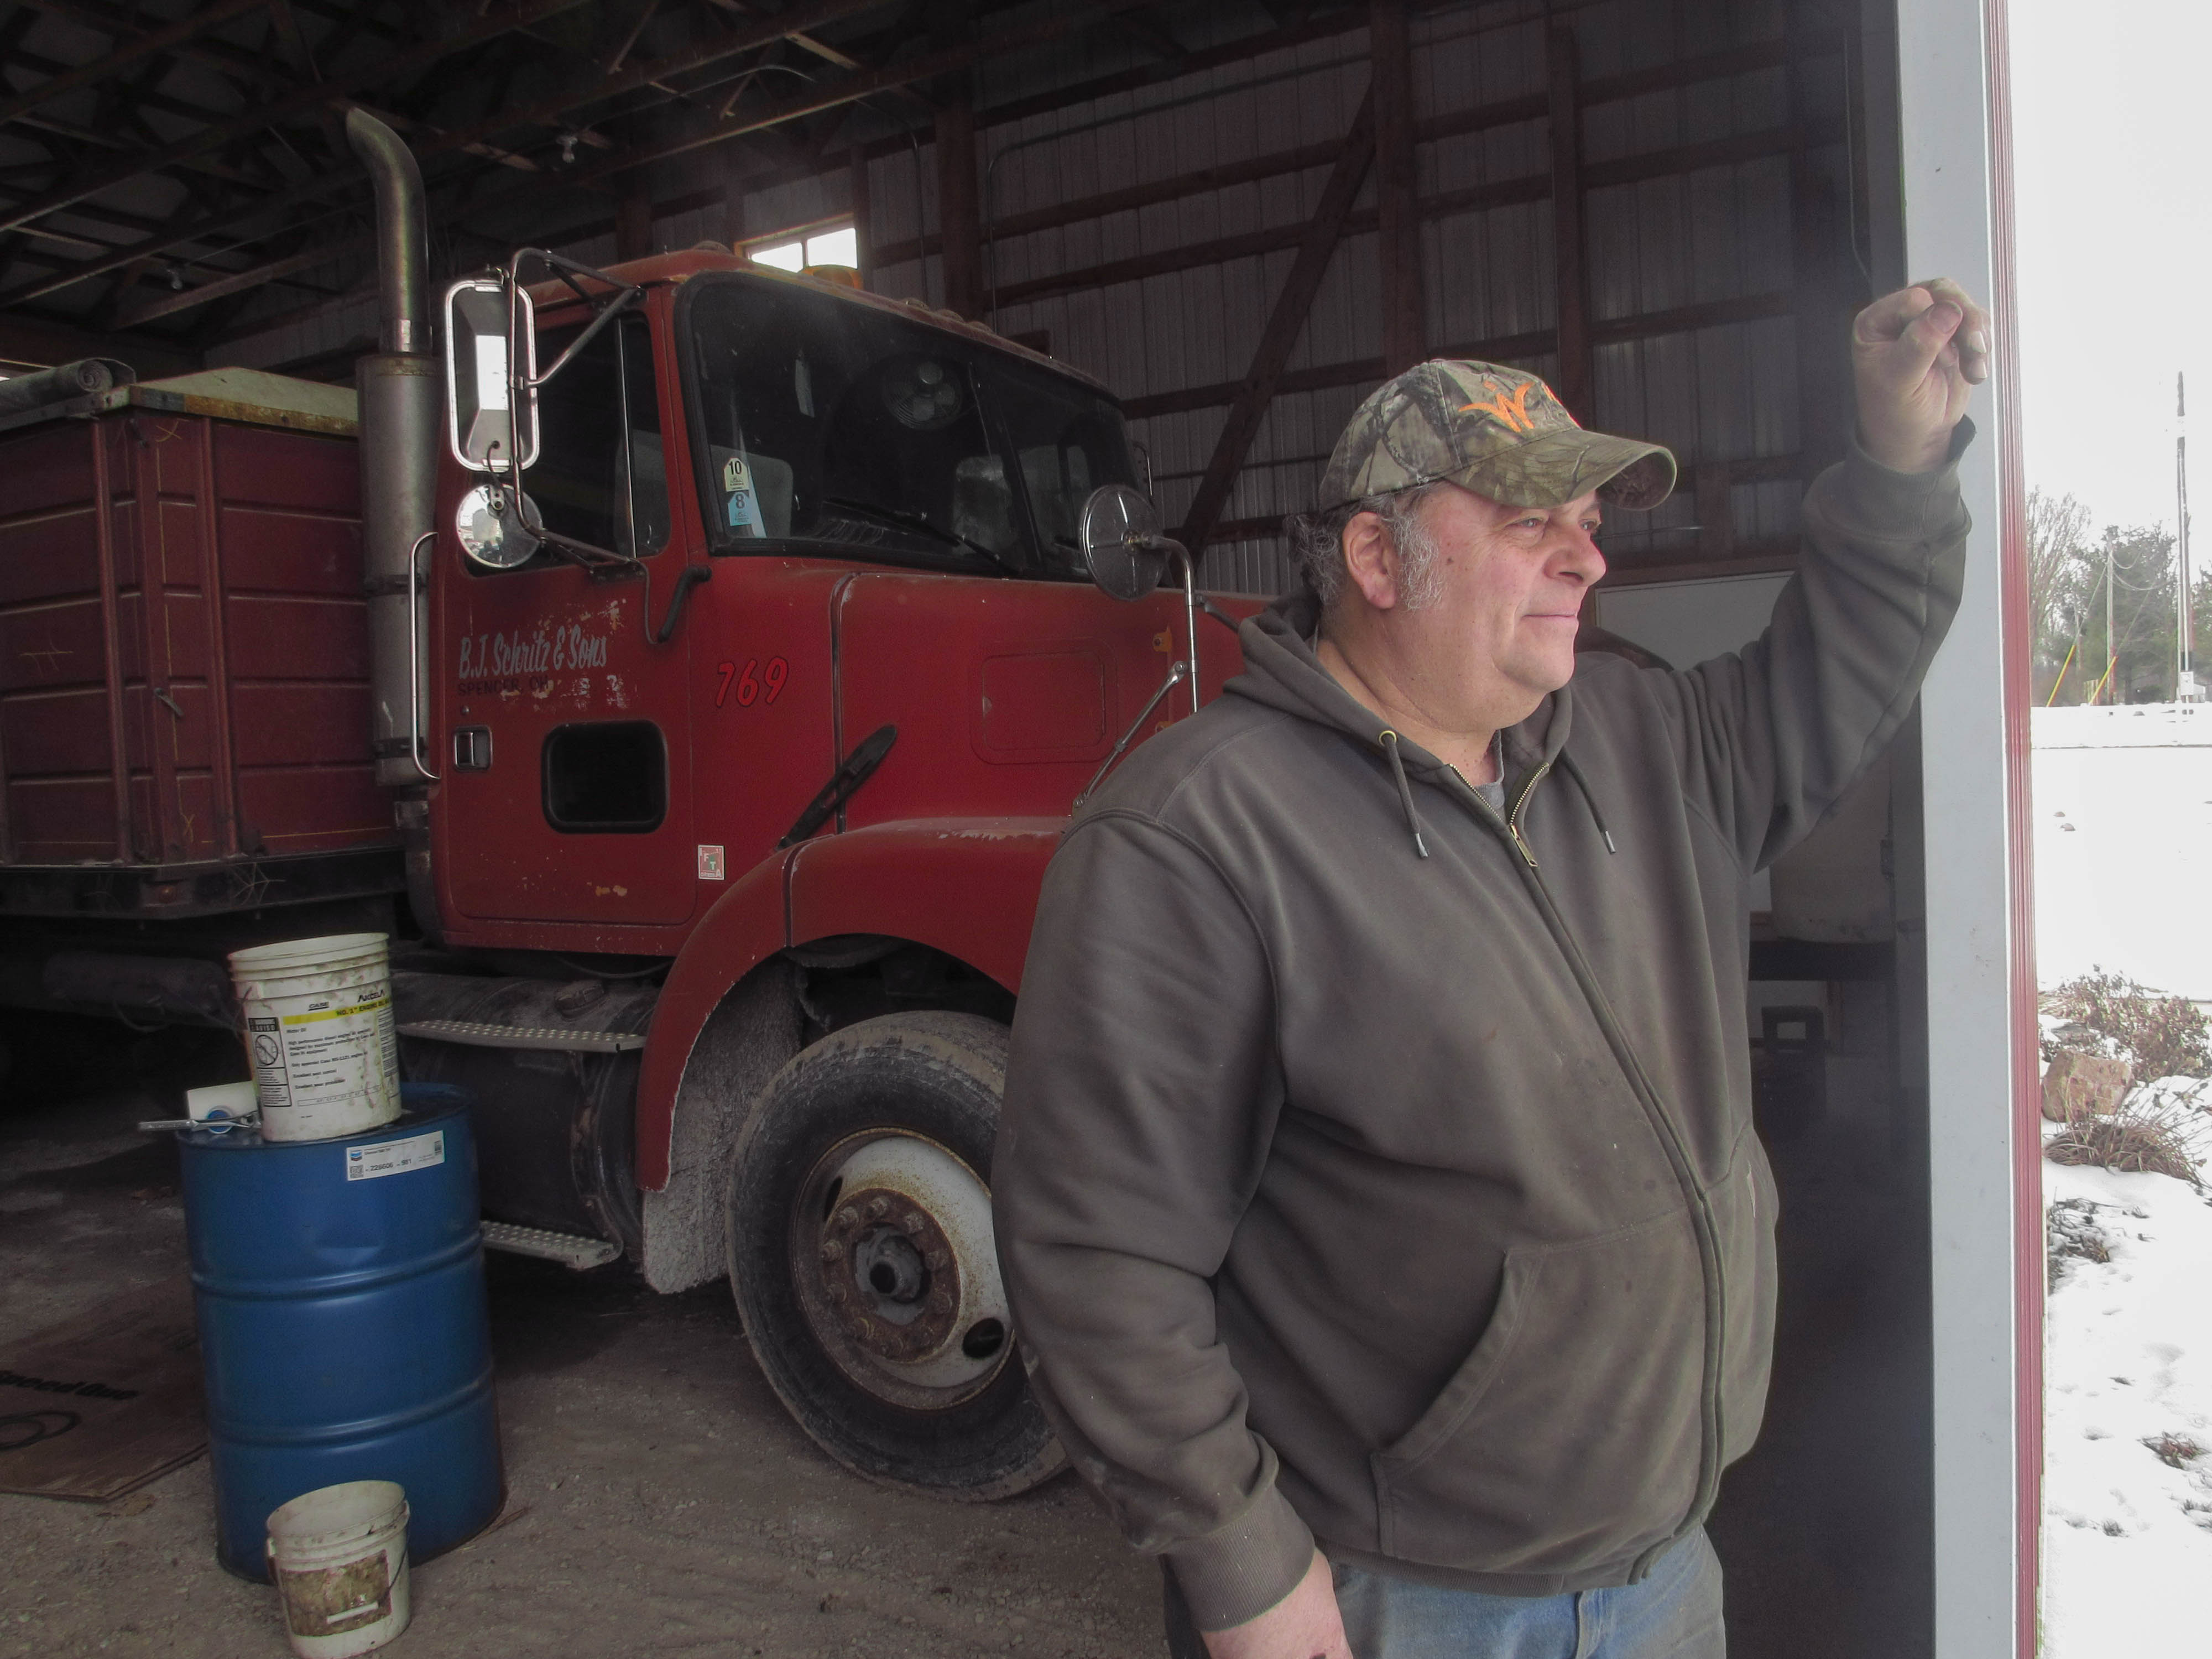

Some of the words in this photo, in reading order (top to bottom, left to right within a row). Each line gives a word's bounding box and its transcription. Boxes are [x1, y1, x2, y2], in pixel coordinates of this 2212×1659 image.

[729, 461, 742, 475] 10
[736, 493, 745, 509] 8
[458, 634, 489, 680] B.J.
[552, 625, 566, 671] &
[567, 623, 608, 670] Sons
[528, 674, 549, 692] OH
[716, 656, 790, 708] 769
